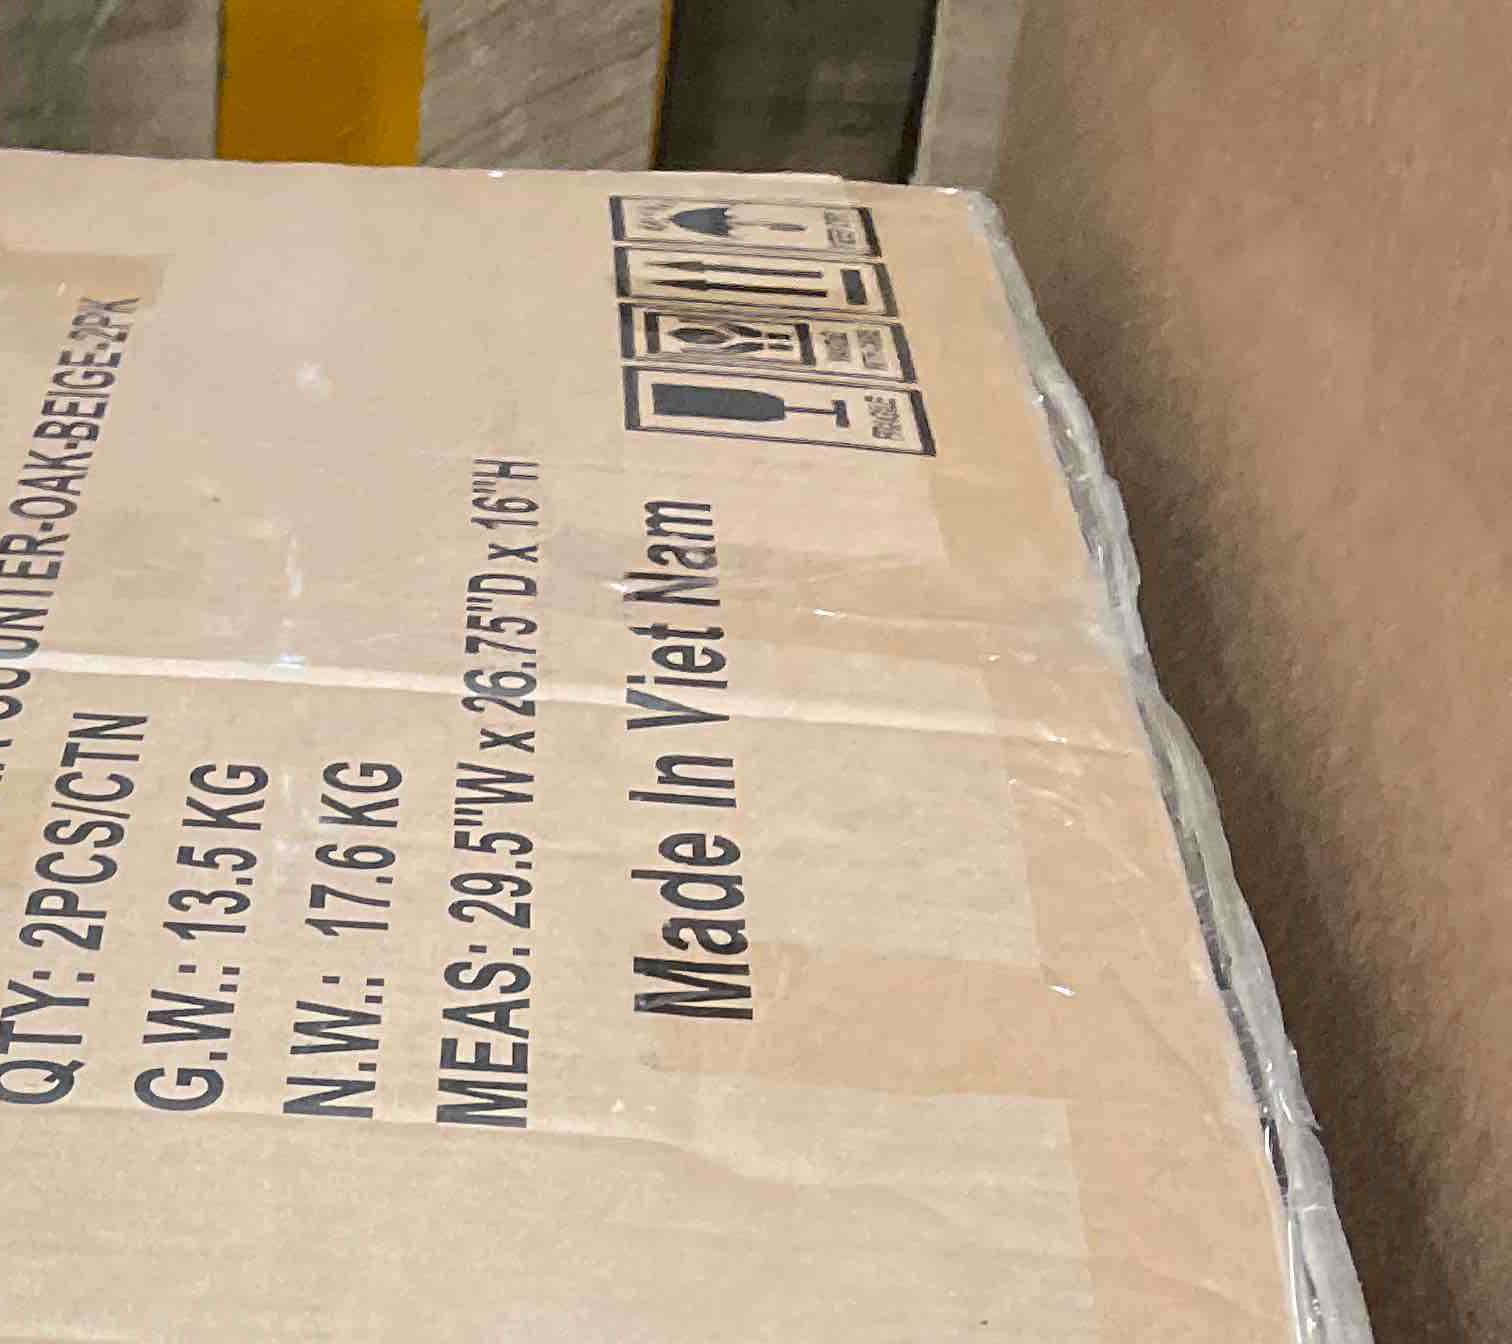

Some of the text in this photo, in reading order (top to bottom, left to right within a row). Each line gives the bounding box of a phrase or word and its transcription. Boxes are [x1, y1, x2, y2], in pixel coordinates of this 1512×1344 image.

[488, 543, 538, 563] x
[25, 713, 148, 950] 2PCS/CTN
[479, 729, 535, 753] x
[624, 500, 753, 1020] Made In Viet Nam
[134, 761, 269, 1112] G.W.: 13.5 KG
[283, 761, 403, 1119] N.W.: 17.6 KG
[436, 945, 530, 1128] MEAS:
